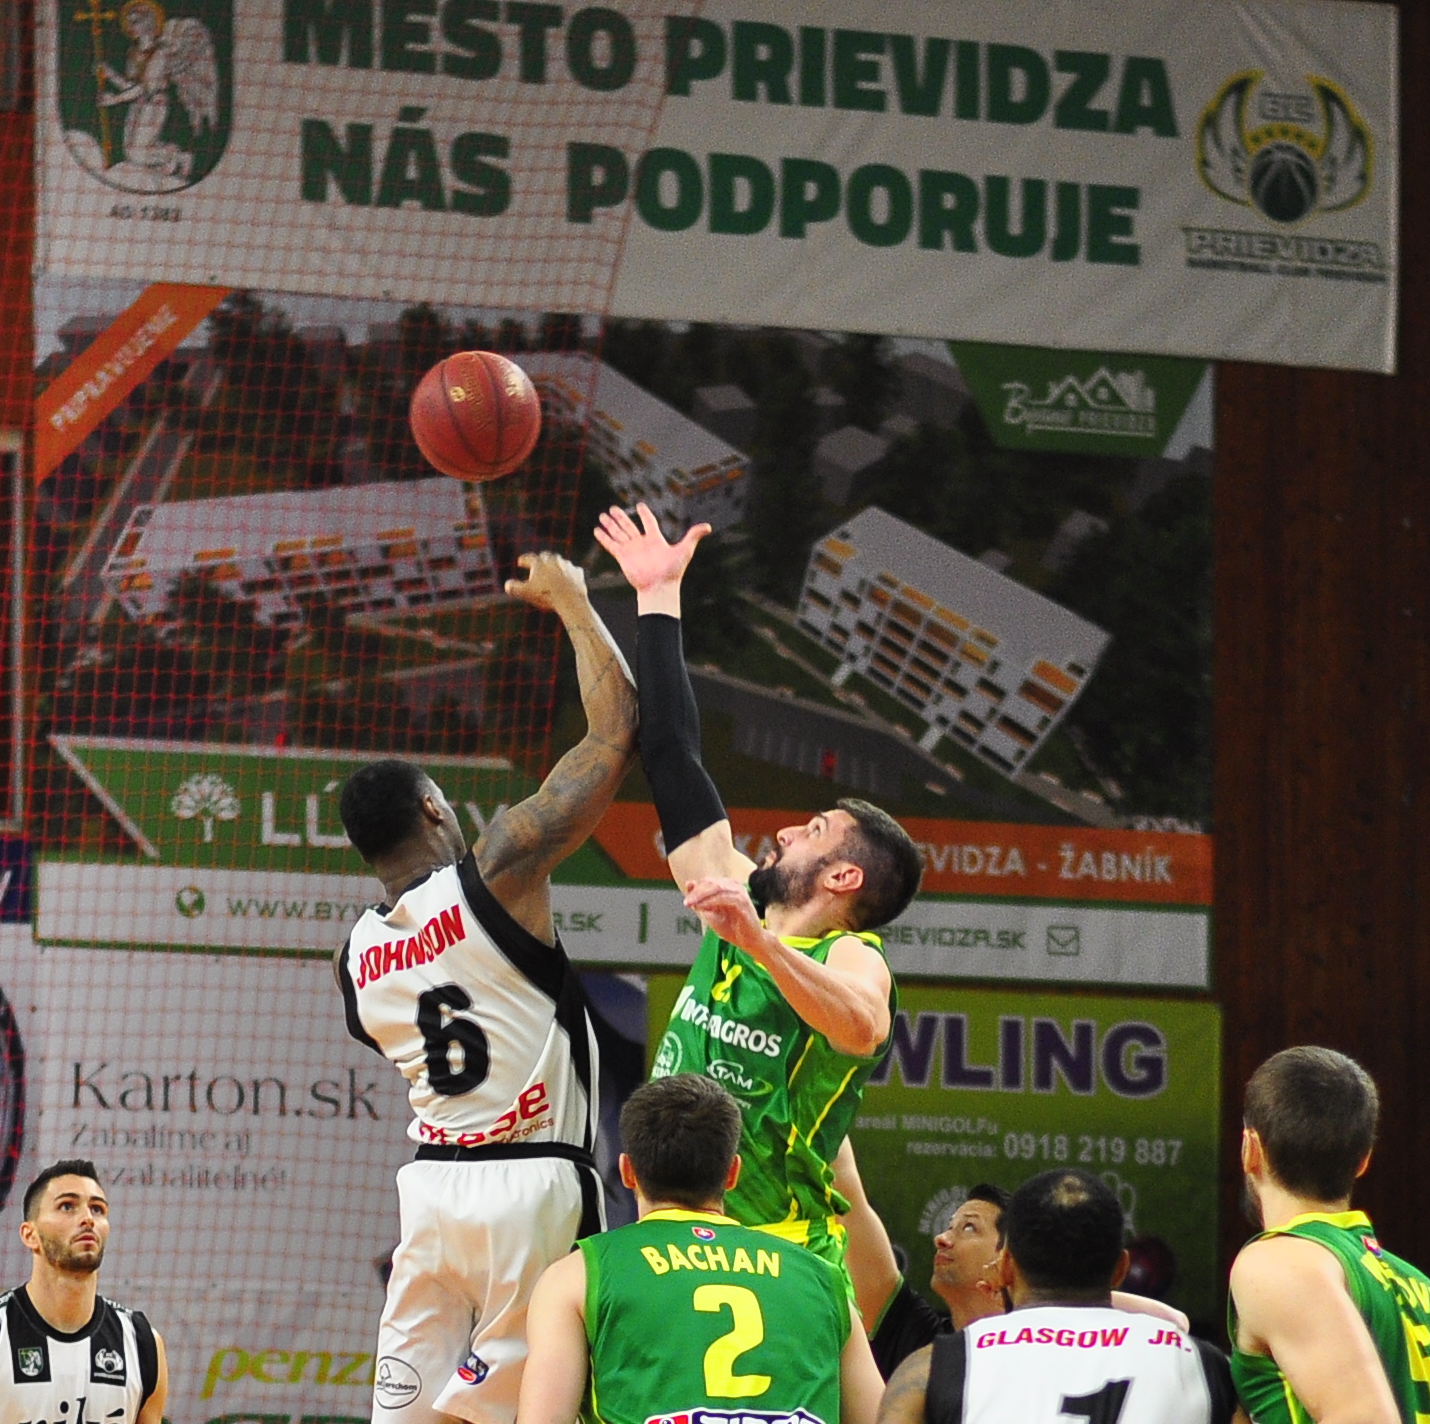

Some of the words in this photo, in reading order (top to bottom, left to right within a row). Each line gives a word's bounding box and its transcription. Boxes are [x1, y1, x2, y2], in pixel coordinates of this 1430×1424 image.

[283, 0, 634, 90] MESTO
[665, 14, 1179, 138] PRIEVIDZA
[302, 107, 512, 217] NÁS
[566, 140, 1141, 265] PODPORUJE
[357, 905, 466, 989] JOHNSON
[417, 983, 491, 1096] 6
[874, 1008, 1169, 1098] WLING
[72, 1062, 379, 1121] Karton.sk
[1004, 1132, 1069, 1161] 0918
[1077, 1136, 1127, 1162] 219
[1135, 1139, 1184, 1165] 887
[640, 1243, 780, 1278] BACHAN
[199, 1346, 371, 1401] penz
[692, 1285, 773, 1398] 2
[976, 1327, 1129, 1349] GLASGOW
[1148, 1329, 1192, 1352] JR.
